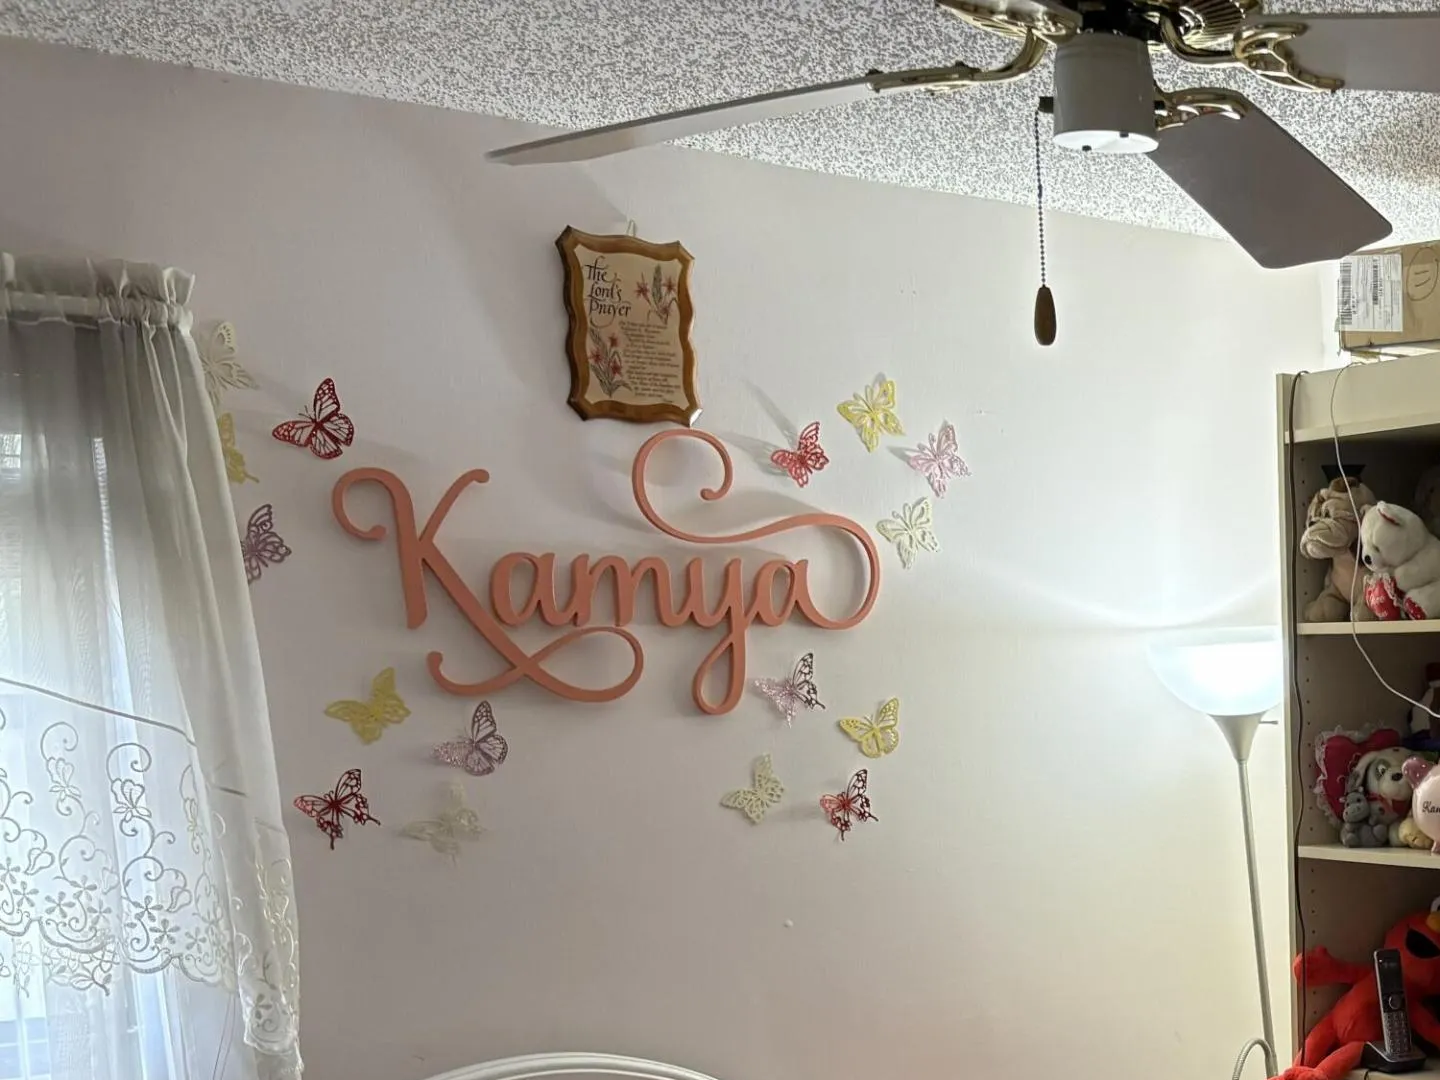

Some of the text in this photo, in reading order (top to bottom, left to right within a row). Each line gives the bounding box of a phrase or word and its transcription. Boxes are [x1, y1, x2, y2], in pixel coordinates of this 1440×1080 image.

[584, 255, 611, 282] The
[587, 272, 622, 301] Lord's
[589, 300, 631, 328] Prayer
[332, 428, 881, 715] Kamya
